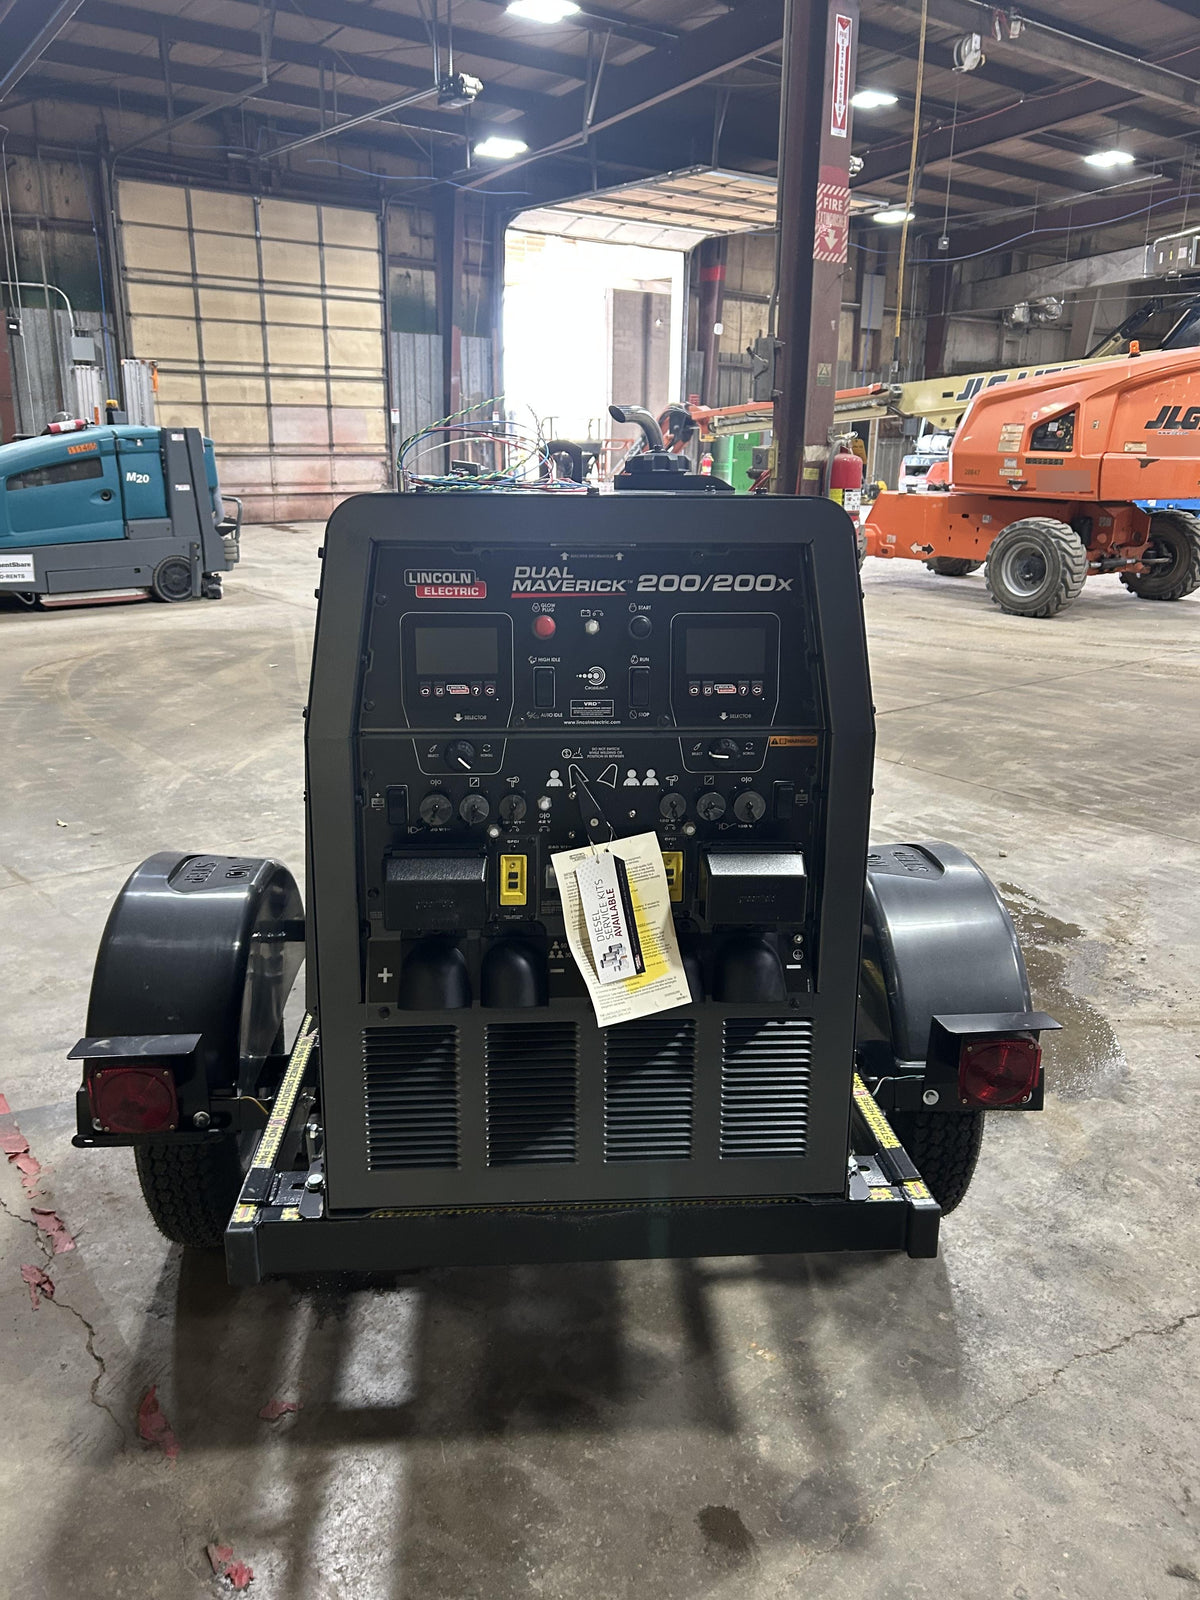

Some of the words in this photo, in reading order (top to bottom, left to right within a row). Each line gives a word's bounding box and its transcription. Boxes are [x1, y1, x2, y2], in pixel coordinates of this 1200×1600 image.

[823, 197, 843, 212] FIRE
[1144, 405, 1200, 430] JLG
[126, 472, 150, 484] M20
[409, 572, 472, 584] LINCOLN
[514, 566, 574, 578] DUAL
[424, 586, 480, 596] ELECTRIC
[224, 864, 254, 878] NO
[892, 852, 929, 872] STEP
[184, 862, 217, 884] STEP
[594, 878, 605, 900] KITS
[599, 902, 614, 940] SERVICE
[606, 888, 622, 937] AVAILABLE
[592, 910, 605, 942] DIESEL
[289, 1059, 302, 1079] TENEZ
[280, 1080, 296, 1106] DEBOUT
[276, 1107, 286, 1117] ICI
[860, 1097, 877, 1116] HERE
[269, 1126, 279, 1138] NO
[264, 1140, 275, 1150] SE
[258, 1150, 271, 1167] PAR
